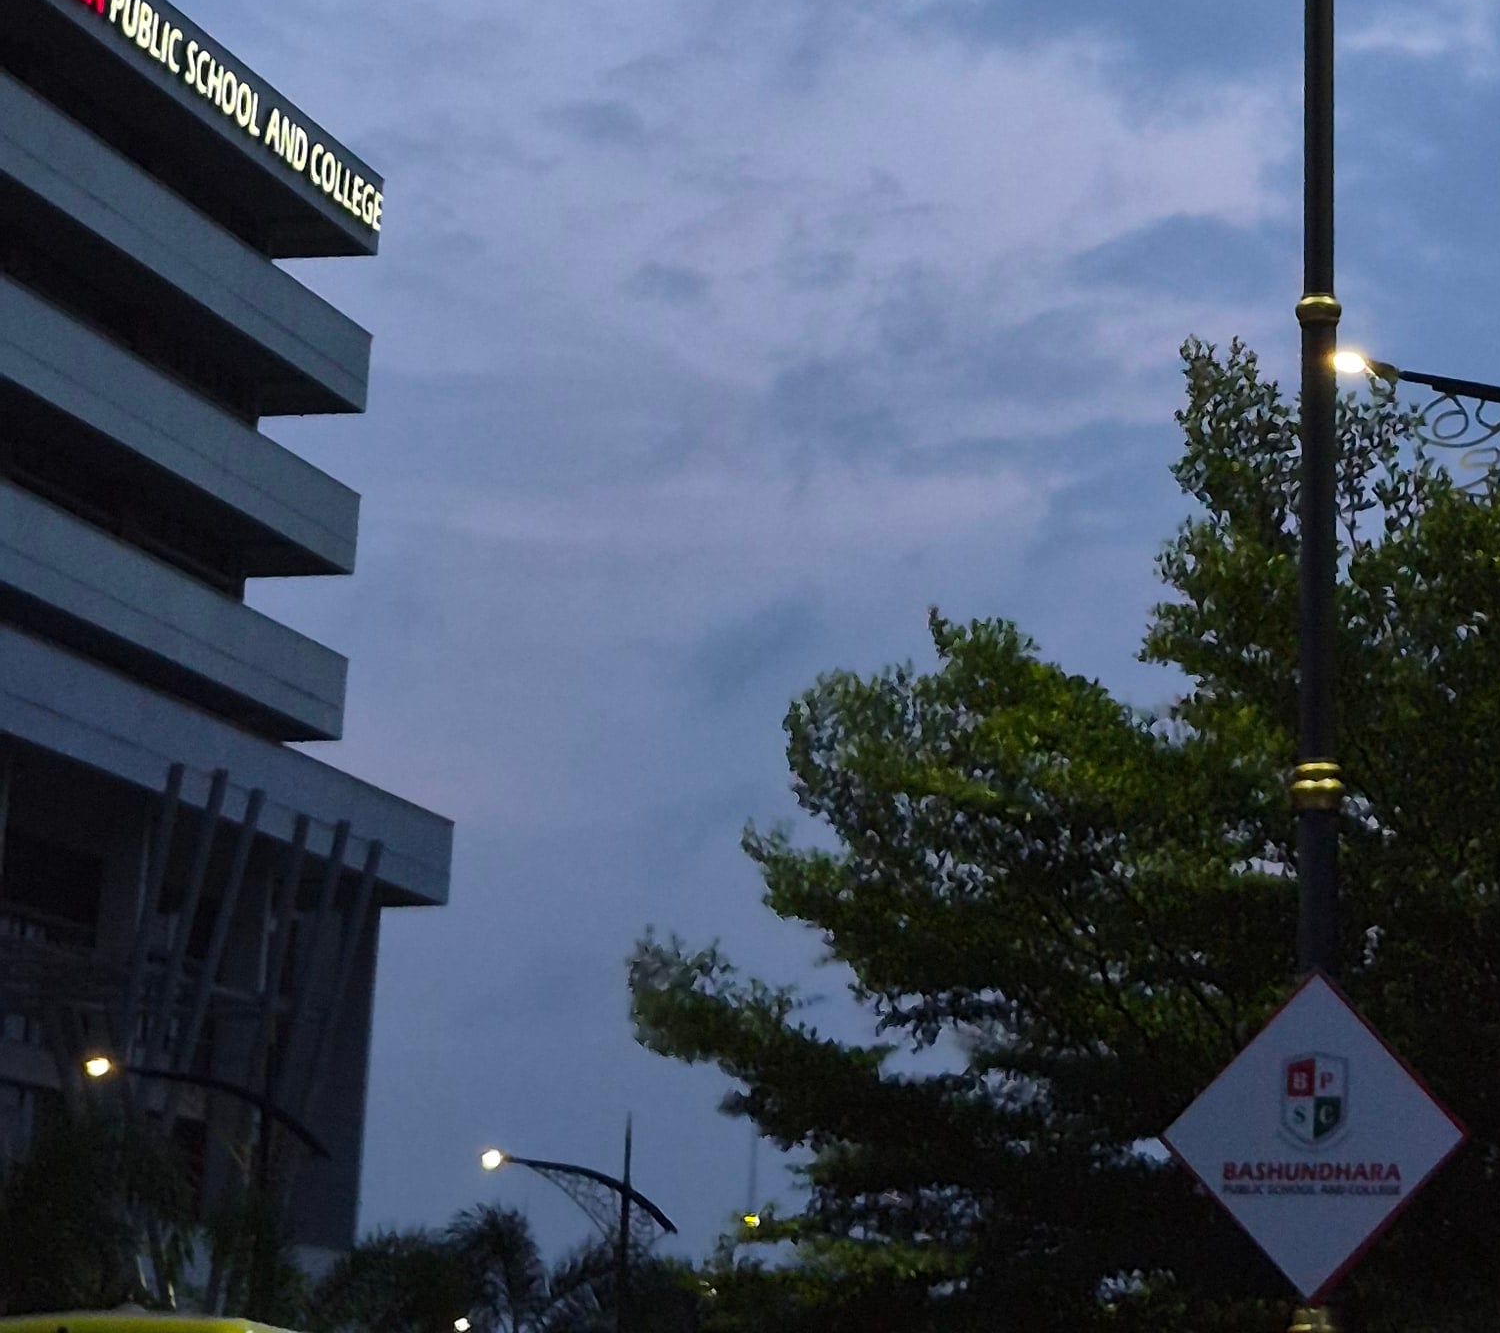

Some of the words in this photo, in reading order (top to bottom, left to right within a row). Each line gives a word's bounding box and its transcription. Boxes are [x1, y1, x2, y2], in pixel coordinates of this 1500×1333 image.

[185, 39, 261, 137] SCHOOL
[264, 107, 309, 173] AND
[309, 142, 385, 232] COLLEGE
[1320, 1071, 1335, 1090] P
[1293, 1105, 1306, 1124] S
[1319, 1105, 1335, 1126] C
[1222, 1162, 1401, 1181] BASHUNDHARA
